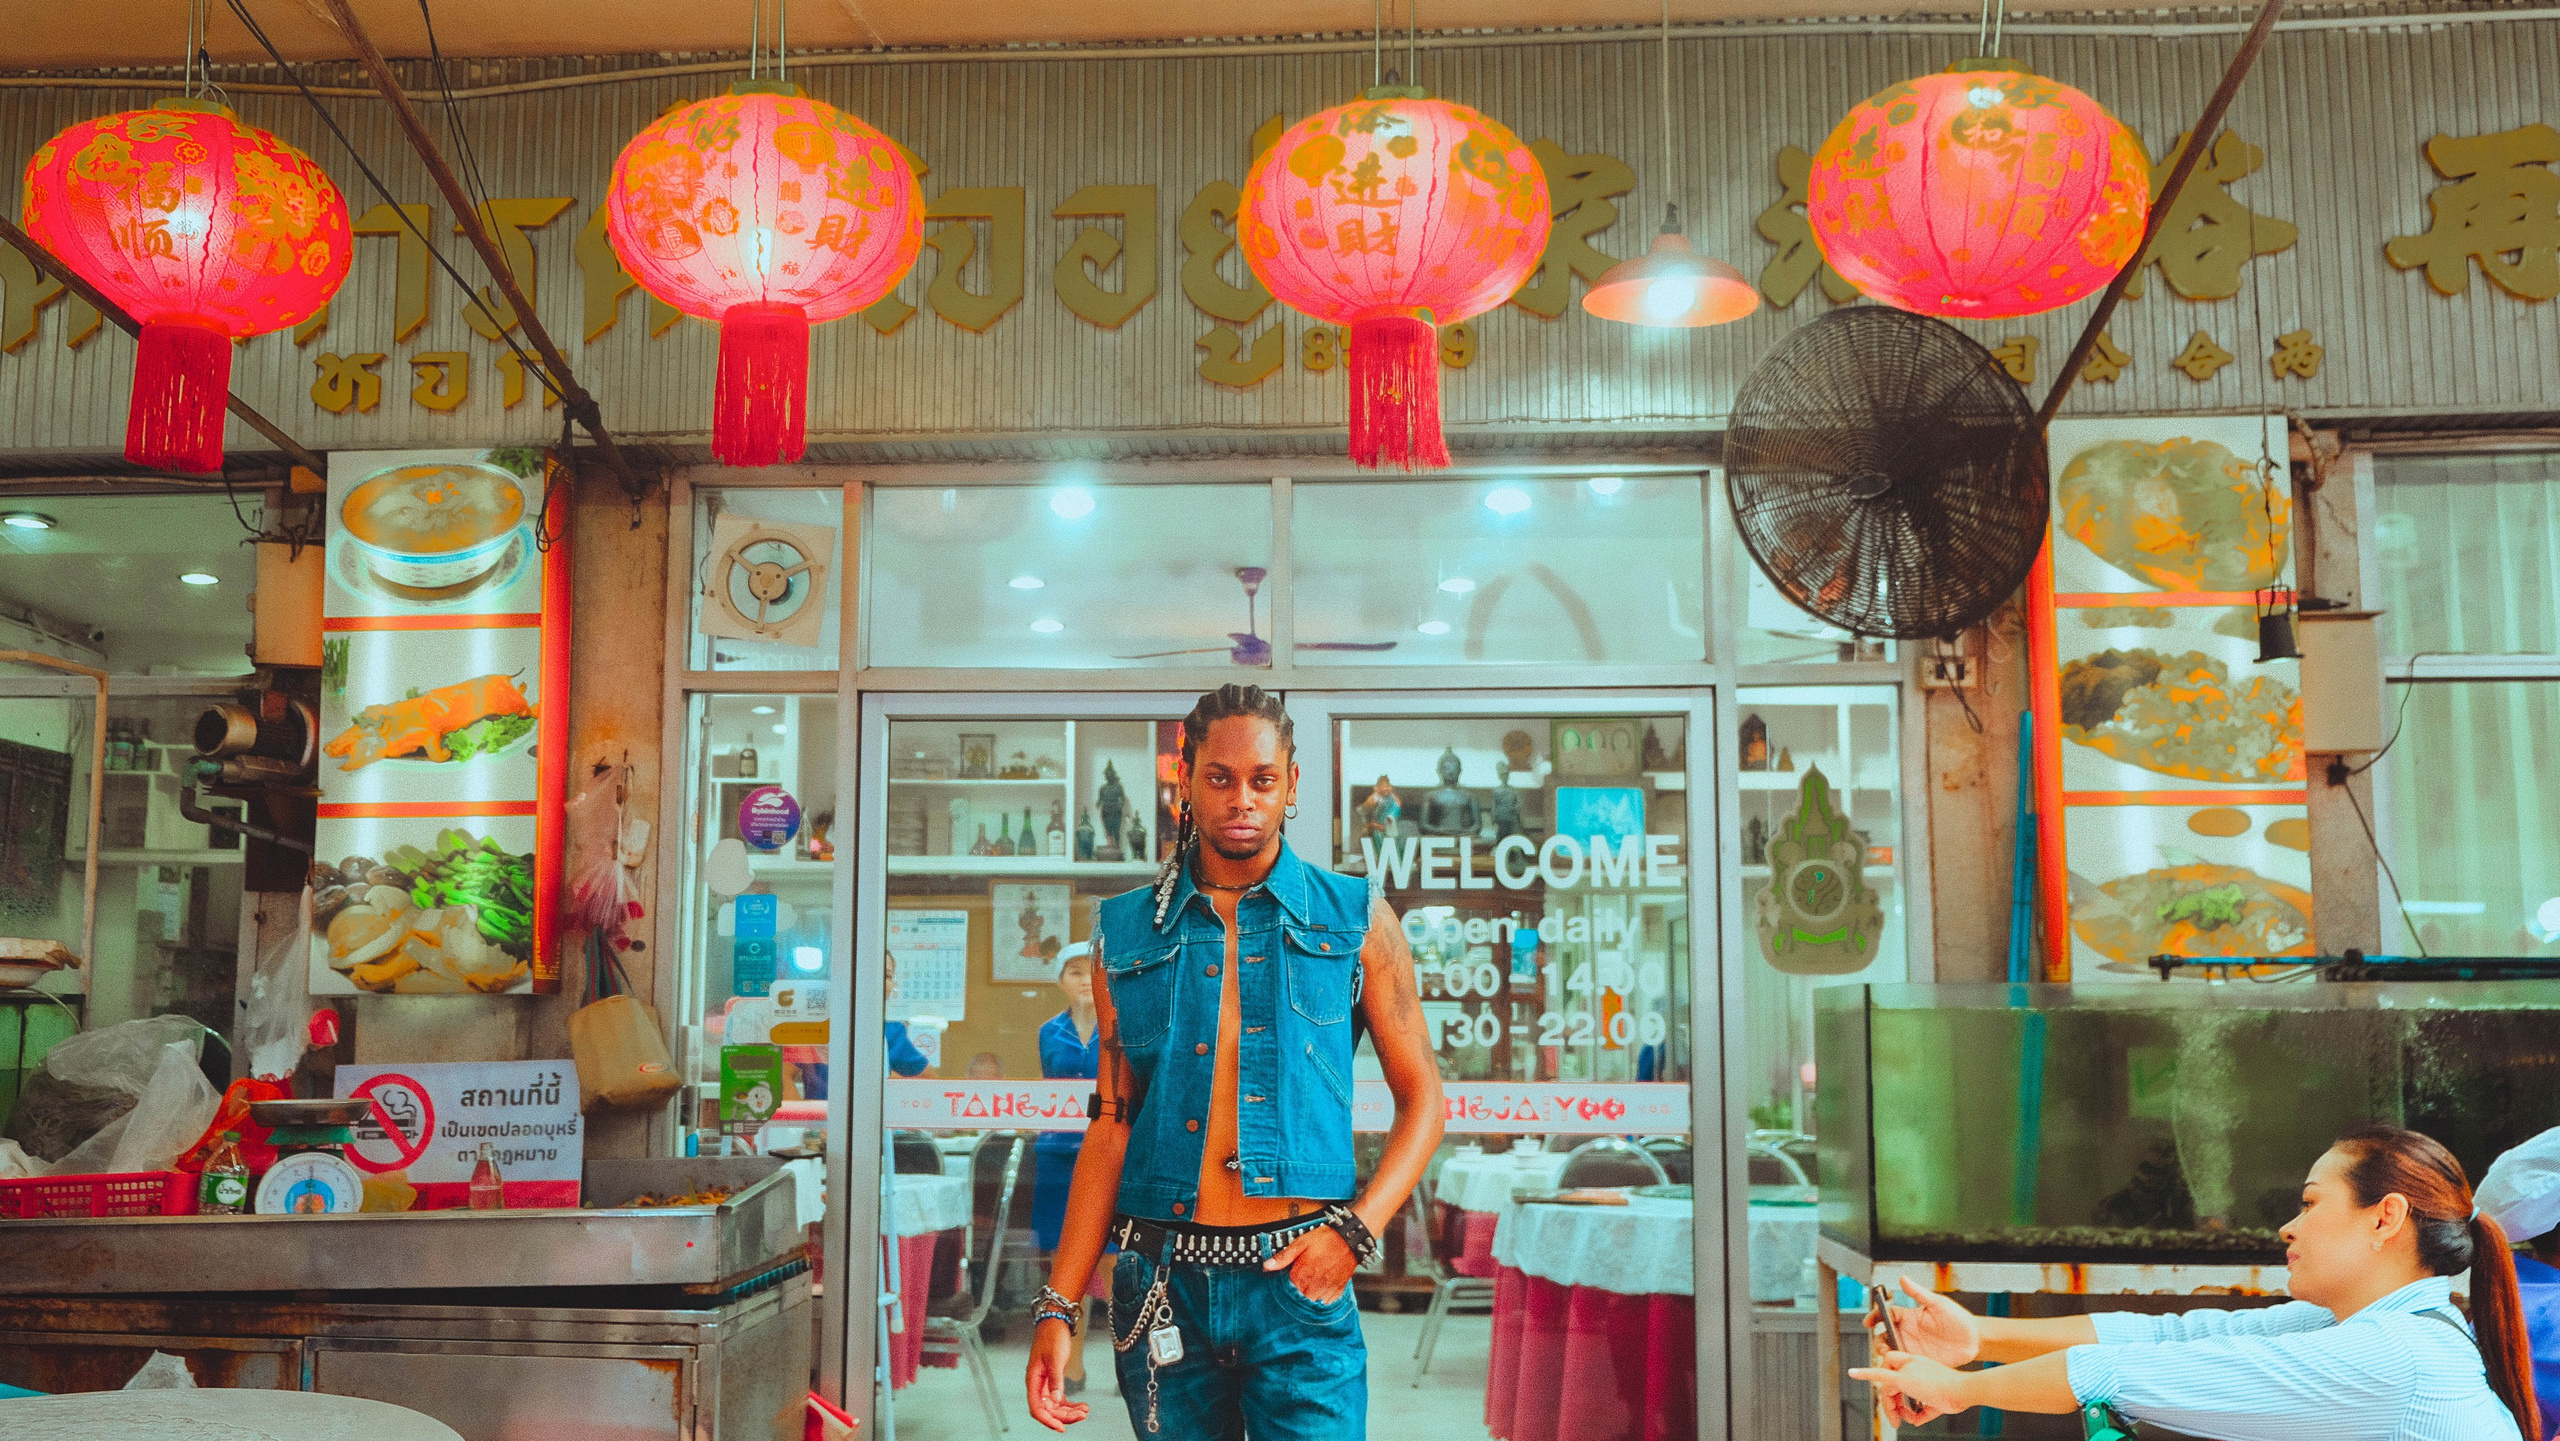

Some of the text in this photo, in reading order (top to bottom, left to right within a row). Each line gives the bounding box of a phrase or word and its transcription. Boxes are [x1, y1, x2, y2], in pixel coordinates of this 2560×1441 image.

[1361, 834, 1682, 890] WELCOME
[1400, 908, 1641, 963] Open daily
[1542, 962, 1665, 998] 14.00
[1538, 1011, 1667, 1048] 22.00
[460, 1072, 562, 1107] สถานที่นี้
[441, 1113, 578, 1141] เป็นเขตปลอดบุหรี่
[457, 1148, 558, 1166] ตากฎหมาย
